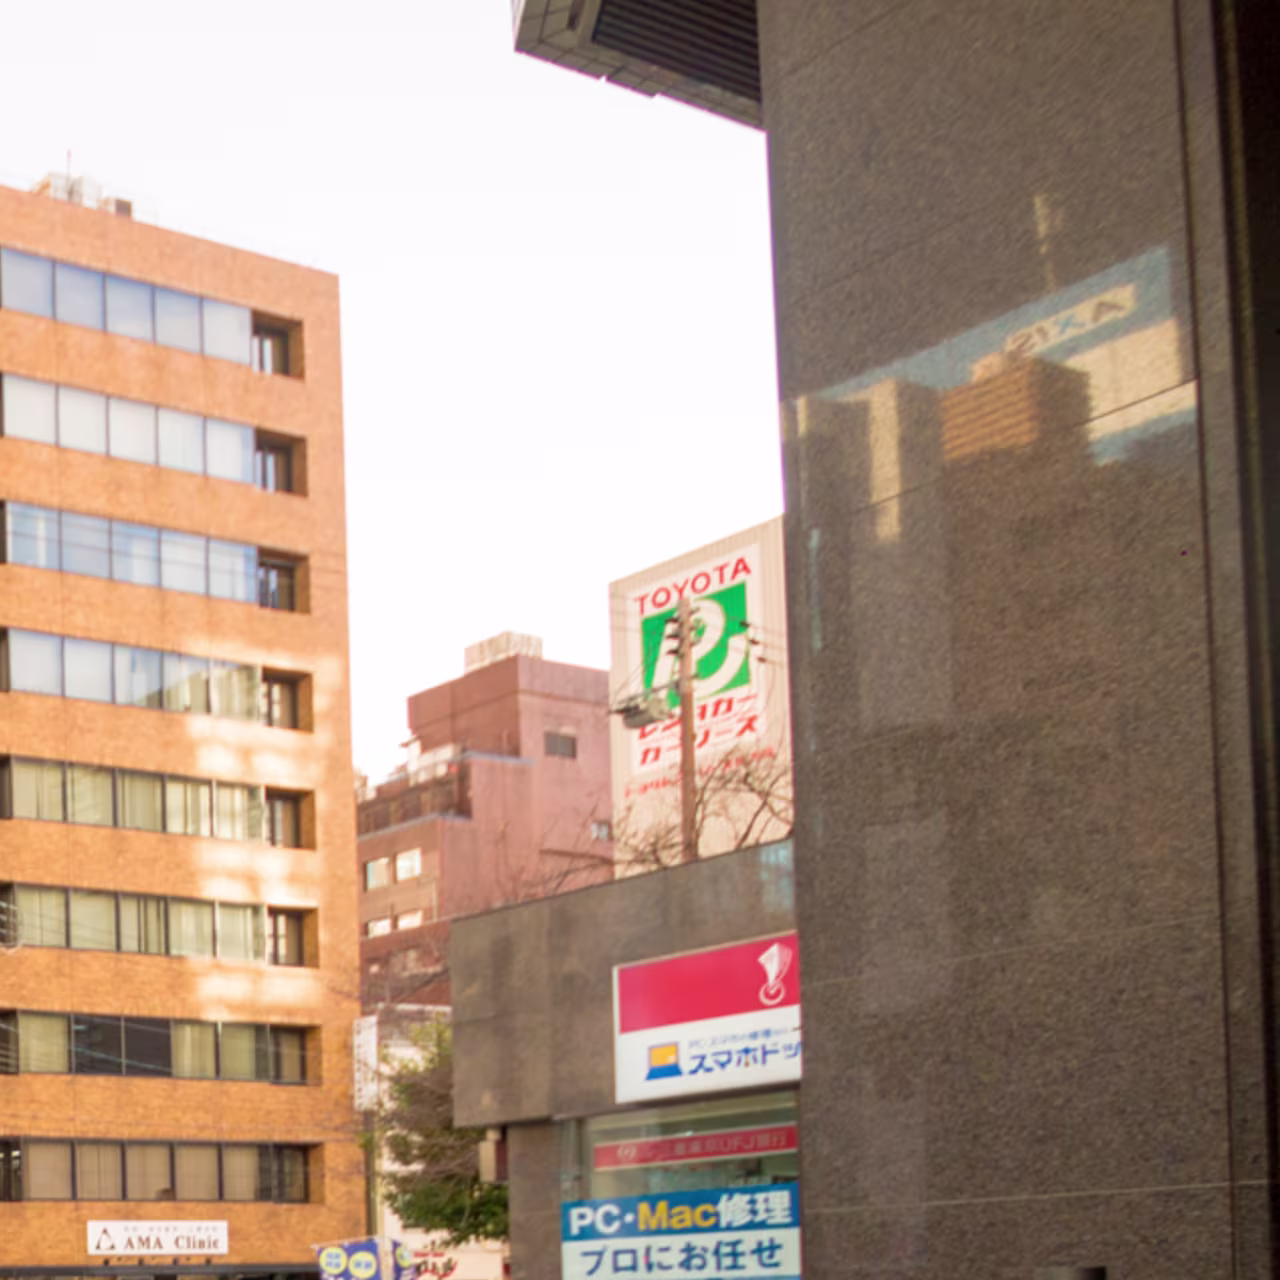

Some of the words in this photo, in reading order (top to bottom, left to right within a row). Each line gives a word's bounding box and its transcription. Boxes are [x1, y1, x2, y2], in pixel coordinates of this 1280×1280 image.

[633, 557, 752, 616] TOYOTA
[569, 1190, 793, 1236] PC・Mac修理
[124, 1235, 164, 1251] AMA
[173, 1234, 220, 1251] Clinic
[580, 1237, 783, 1277] プロにお任せ
